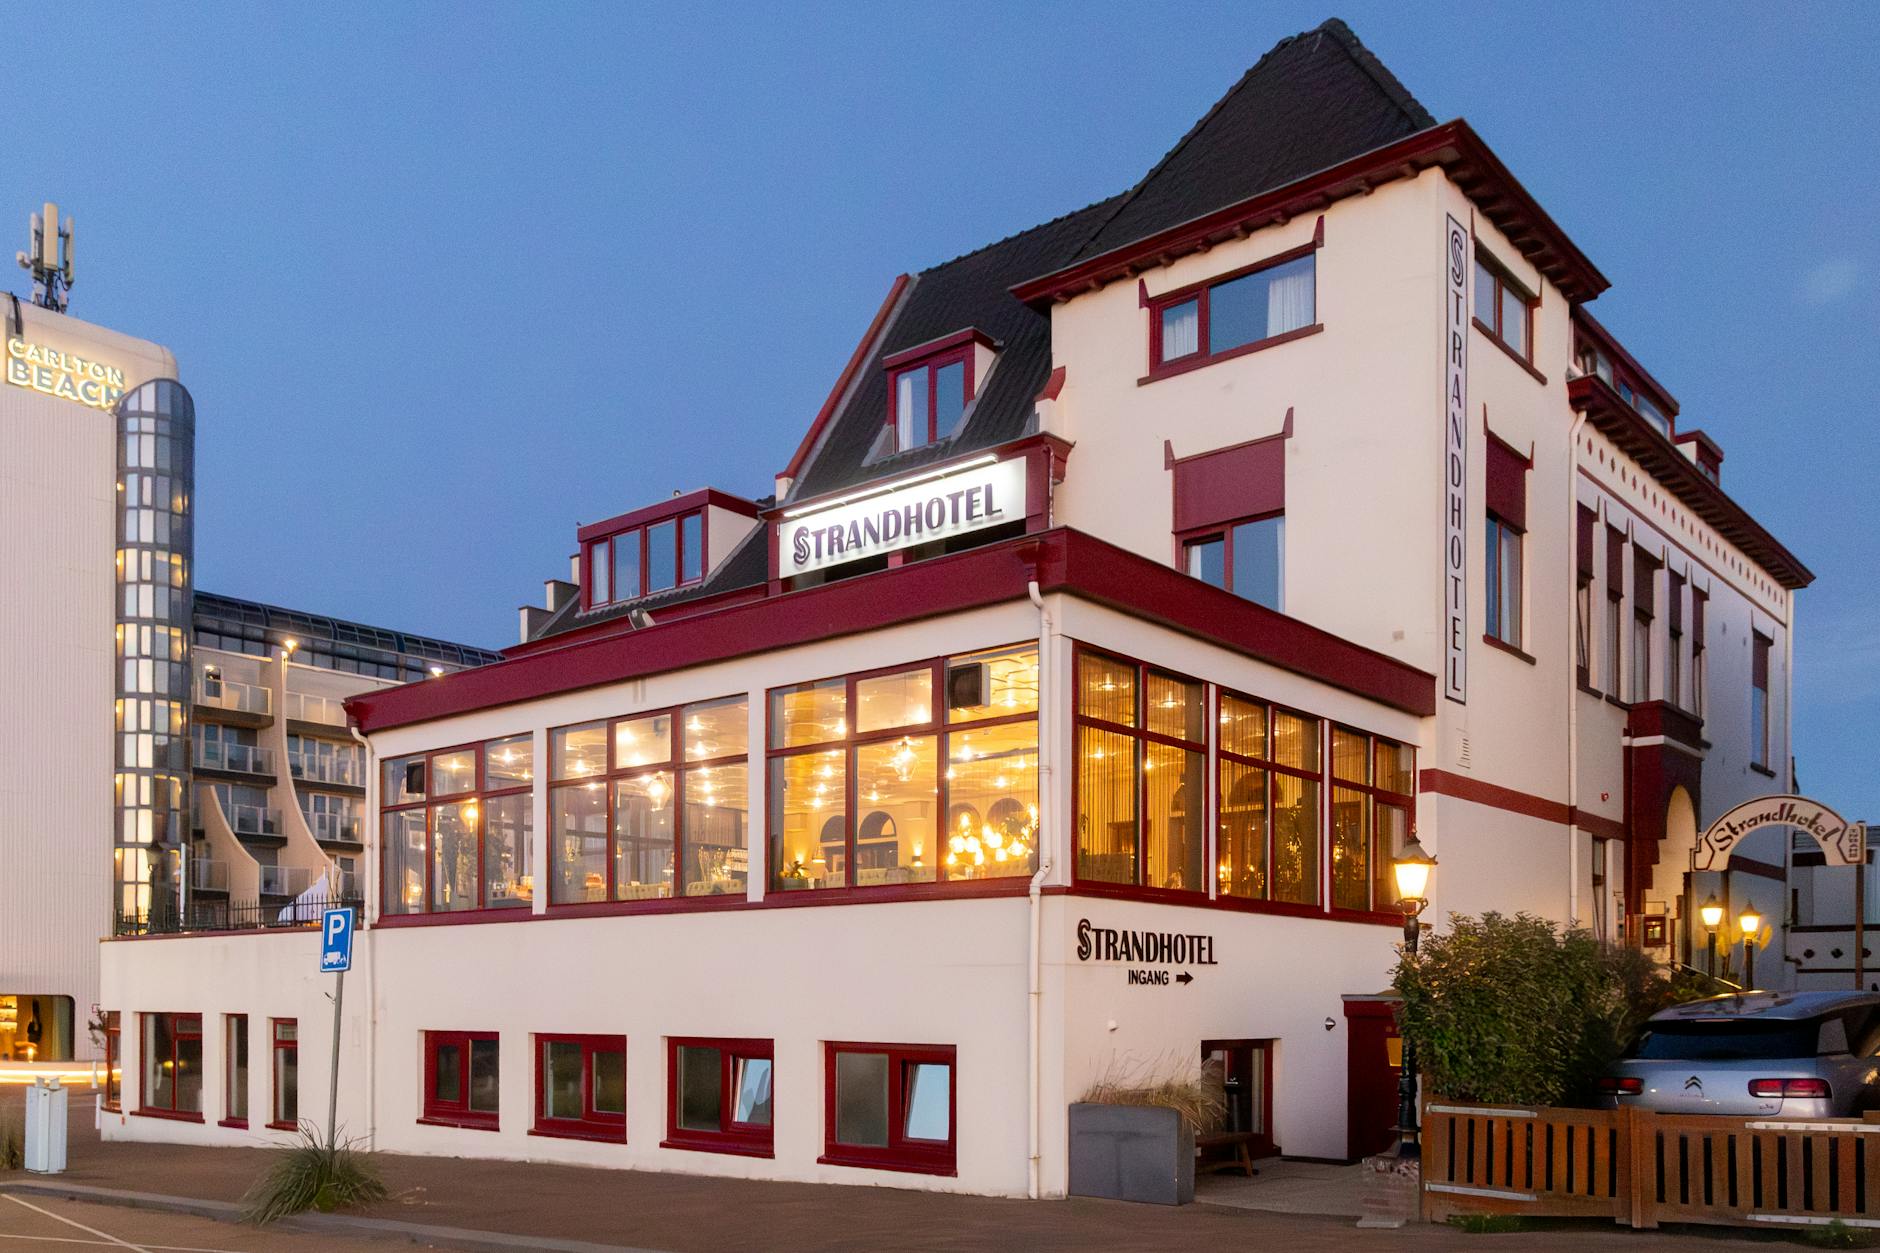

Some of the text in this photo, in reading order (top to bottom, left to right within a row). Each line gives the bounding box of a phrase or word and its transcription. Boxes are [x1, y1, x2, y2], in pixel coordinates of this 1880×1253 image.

[7, 338, 125, 388] CARLTON
[7, 356, 125, 409] BEACH
[1451, 230, 1463, 691] STRANDHOTEL
[793, 483, 1002, 566] STRANDHOTEL
[1714, 802, 1842, 851] Strandhotel
[328, 914, 346, 946] P
[1077, 918, 1218, 962] STRANDHOTEL
[1128, 969, 1169, 986] INGANG
